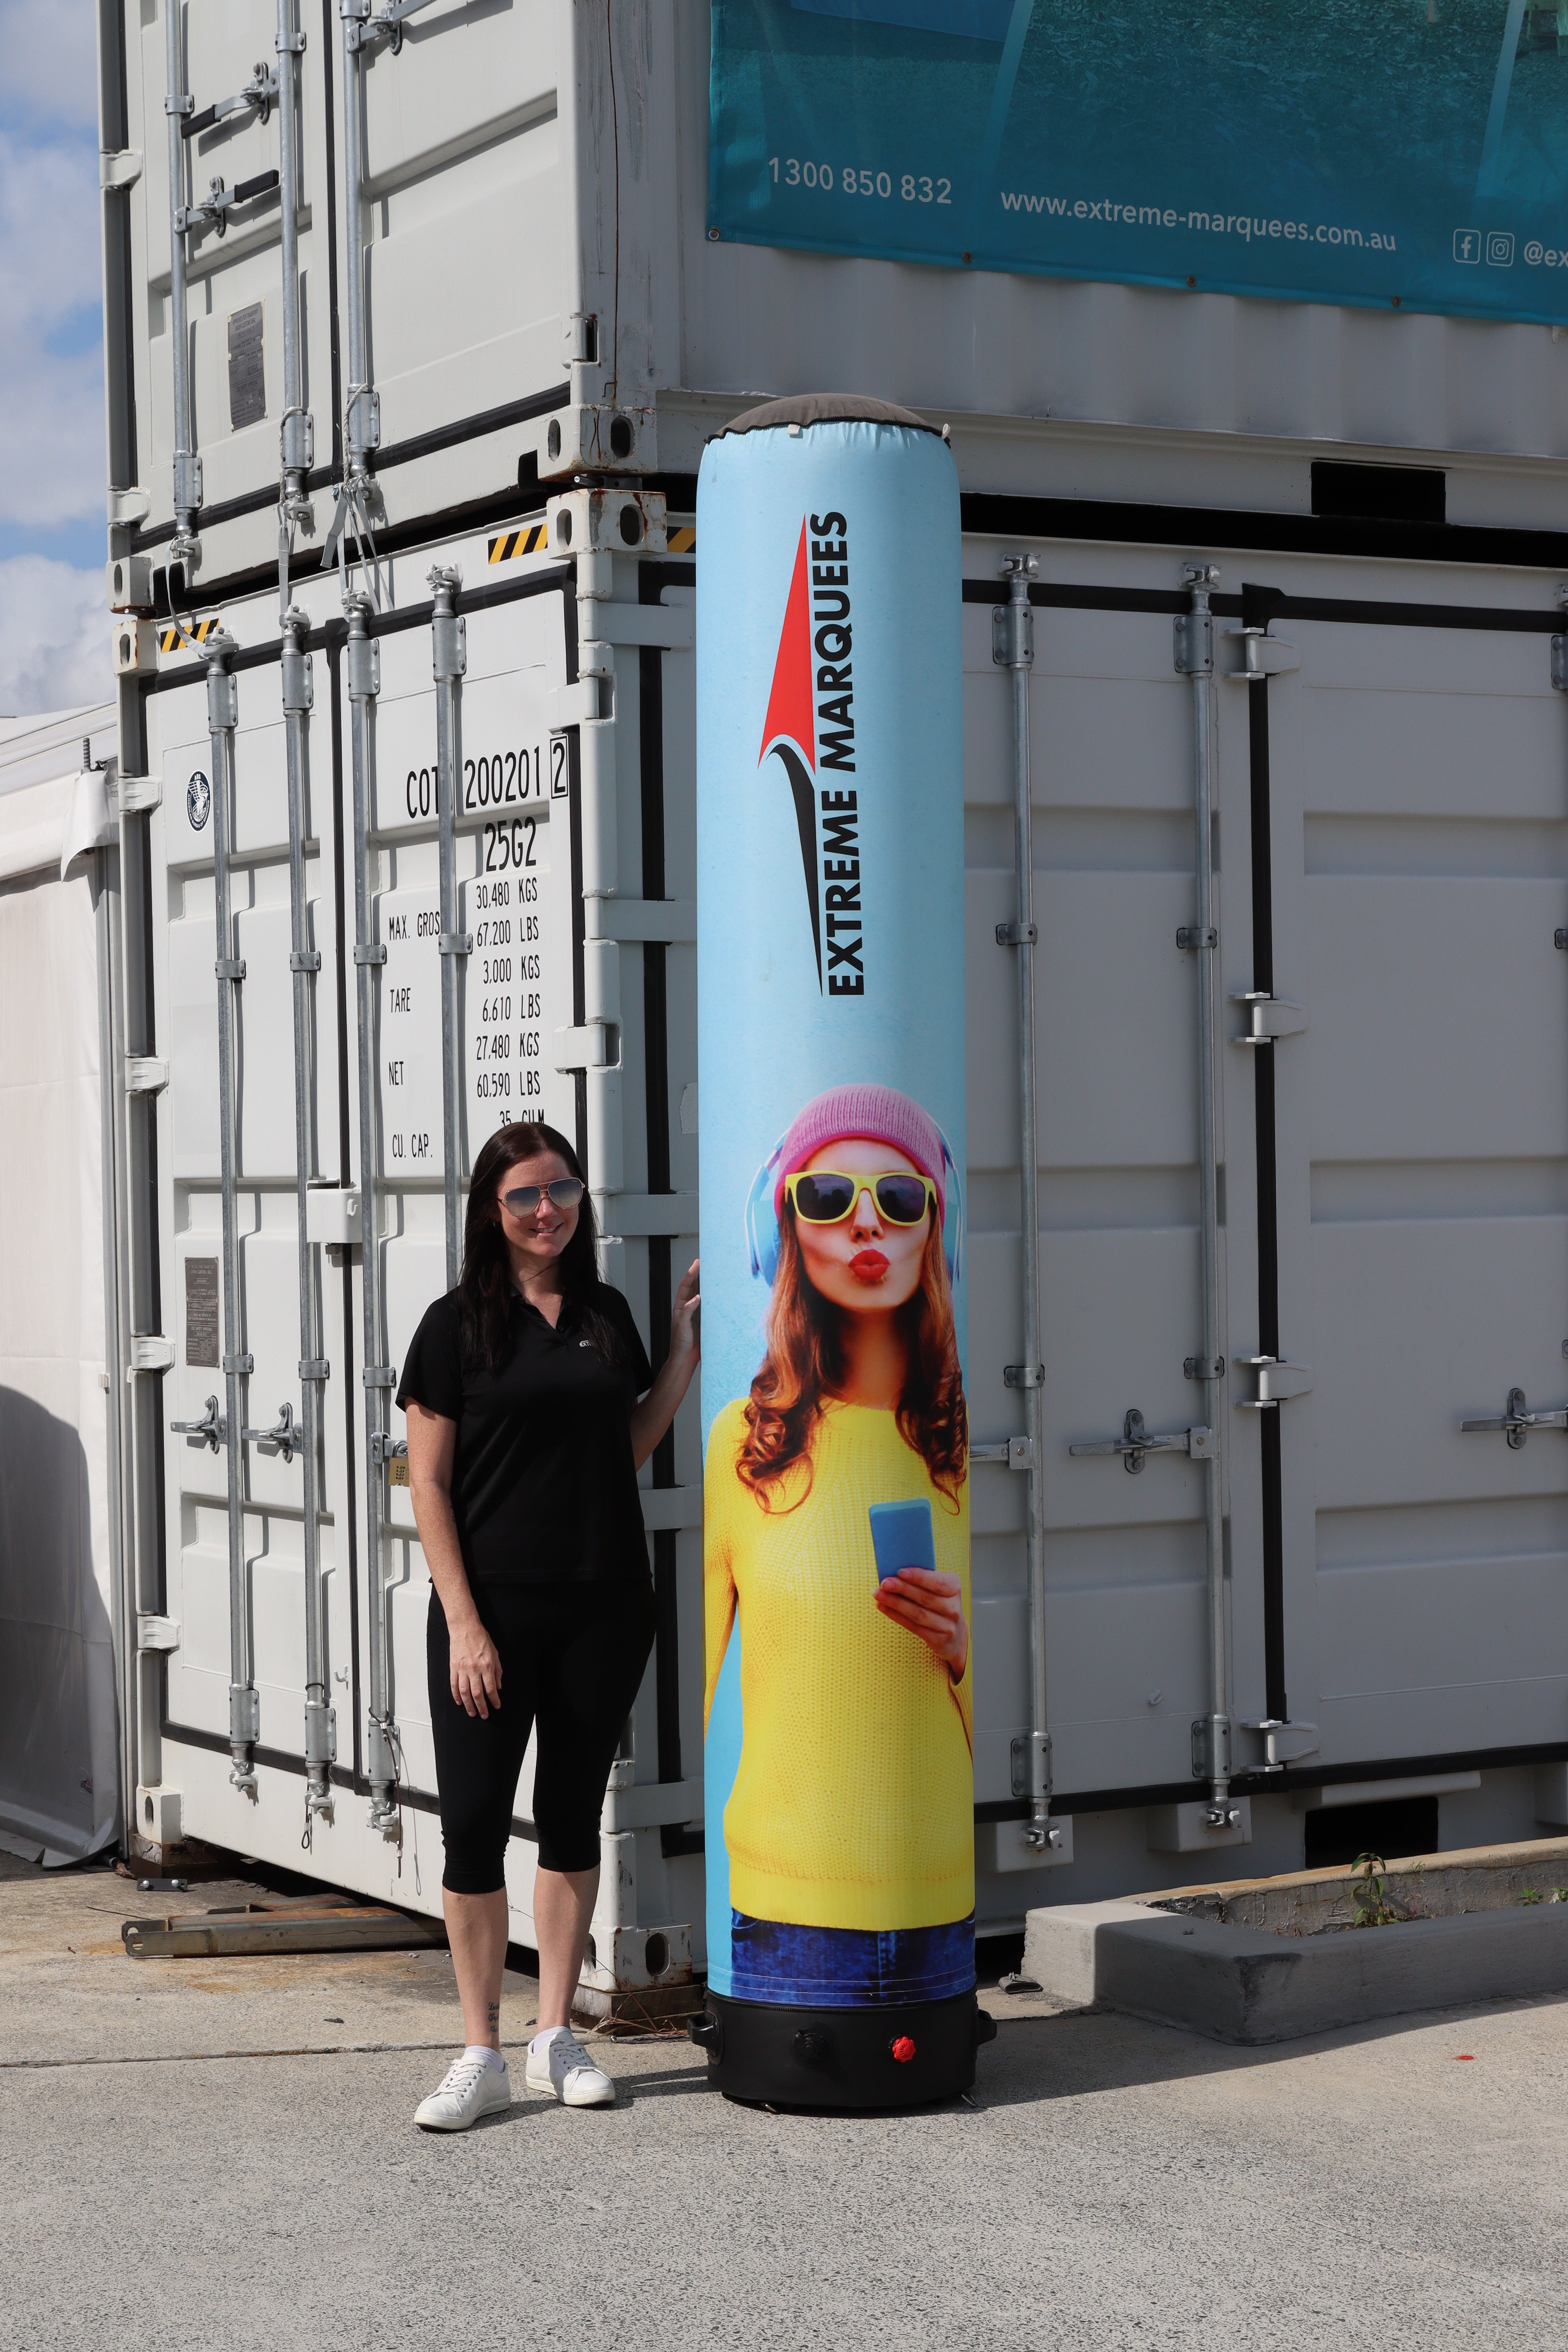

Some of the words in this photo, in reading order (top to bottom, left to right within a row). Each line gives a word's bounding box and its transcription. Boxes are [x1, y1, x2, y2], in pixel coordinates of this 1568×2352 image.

[769, 157, 833, 190] 1300
[842, 168, 891, 198] 850
[901, 175, 951, 204] 832
[1001, 192, 1396, 250] www.extreme-marquees.com.au
[809, 512, 856, 772] MARQUEES
[407, 766, 439, 818] COT
[464, 746, 540, 809] 200201
[553, 742, 566, 794] 2
[485, 817, 536, 872] 25G2
[476, 881, 509, 909] 30,480
[519, 877, 537, 903] KGS
[822, 791, 864, 996] EXTREME
[389, 915, 410, 941] MAX.
[417, 911, 439, 937] GROS
[477, 920, 511, 947] 67,200
[520, 916, 539, 942] LBS
[483, 958, 511, 984] 3,000
[521, 955, 540, 980] KGS
[390, 987, 411, 1013] TARE
[483, 996, 511, 1022] 6,610
[521, 993, 541, 1019] LBS
[476, 1034, 510, 1060] 27,480
[520, 1032, 539, 1057] KGS
[389, 1061, 404, 1085] NET
[477, 1073, 510, 1098] 60,590
[520, 1071, 540, 1096] LBS
[392, 1134, 406, 1158] CU.
[412, 1134, 433, 1158] CAP.
